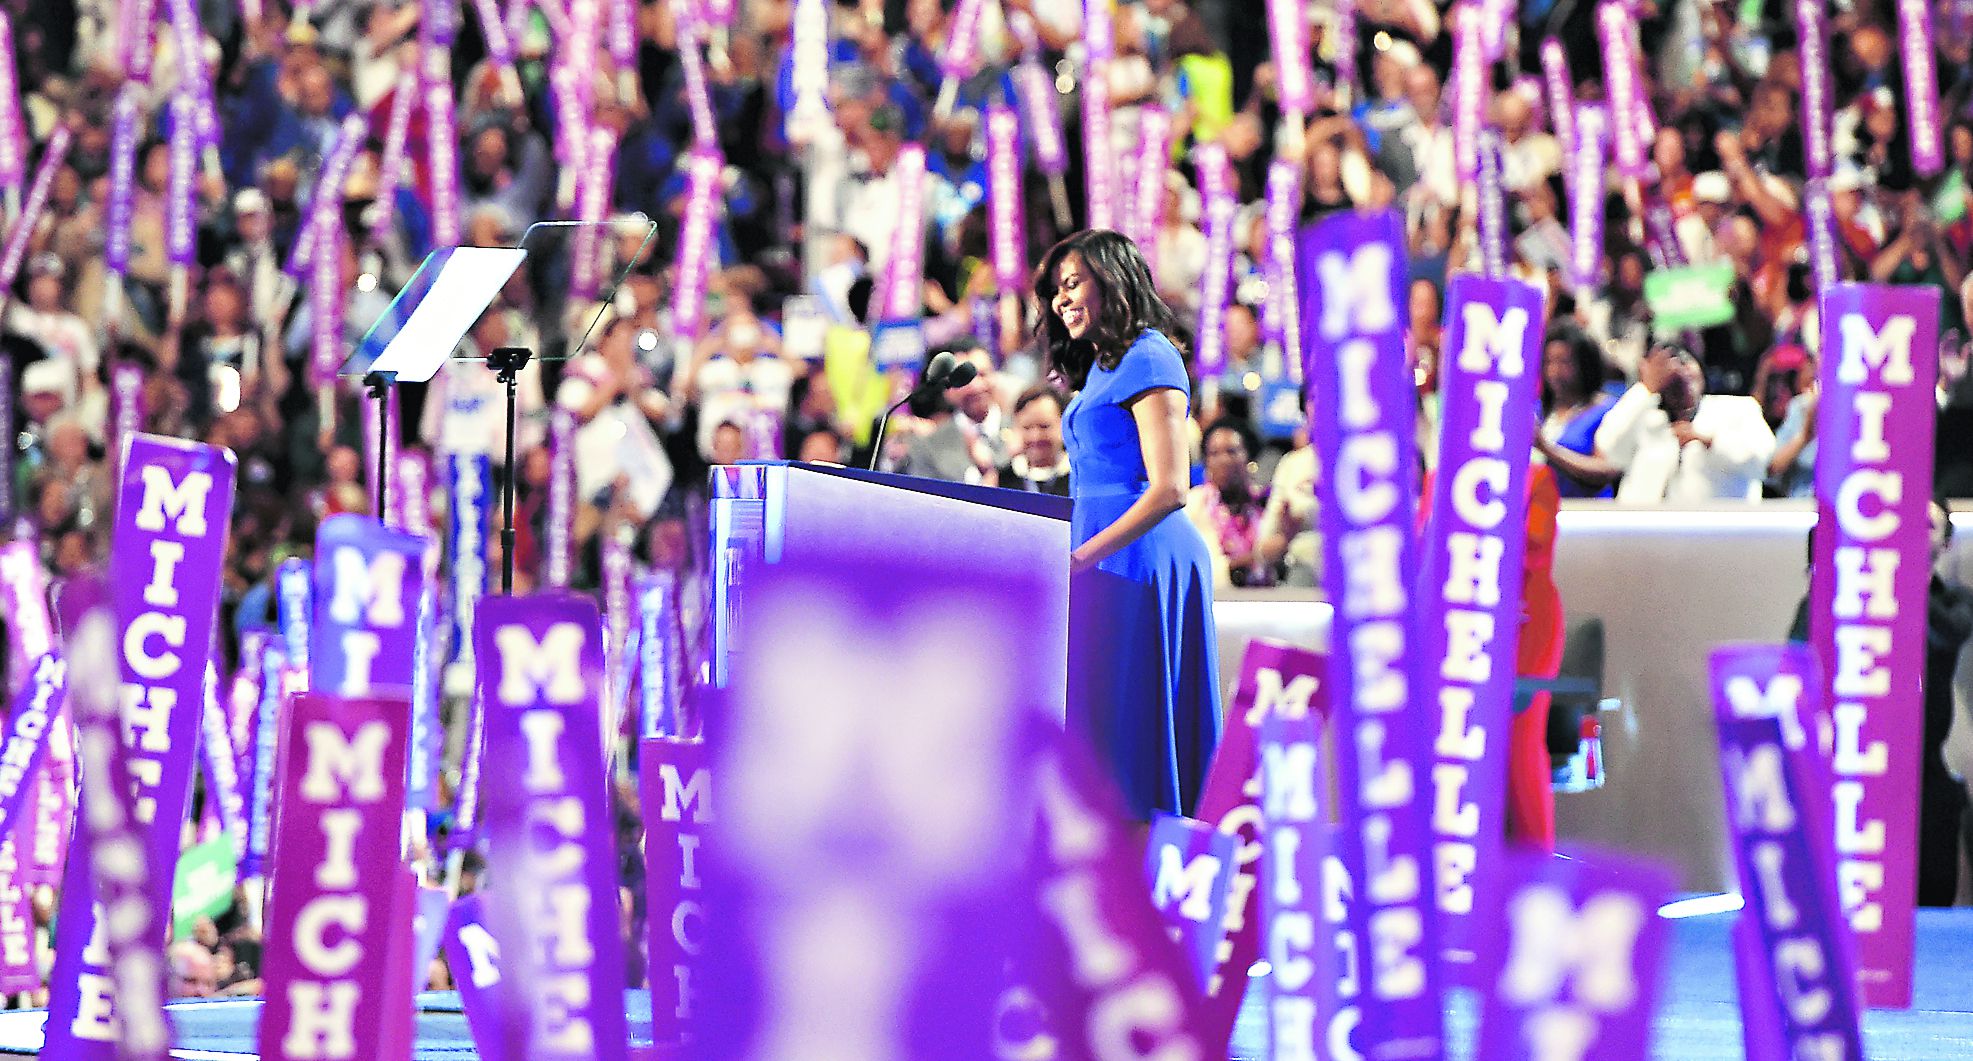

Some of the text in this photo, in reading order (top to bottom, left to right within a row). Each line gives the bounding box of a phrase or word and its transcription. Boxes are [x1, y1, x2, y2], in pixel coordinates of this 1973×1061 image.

[71, 464, 214, 1041] MICHE
[282, 720, 391, 1059] MICH
[1315, 242, 1427, 998] MICHELLE
[1431, 301, 1529, 914] MICHELLE
[1831, 312, 1919, 932] MICHELLE
